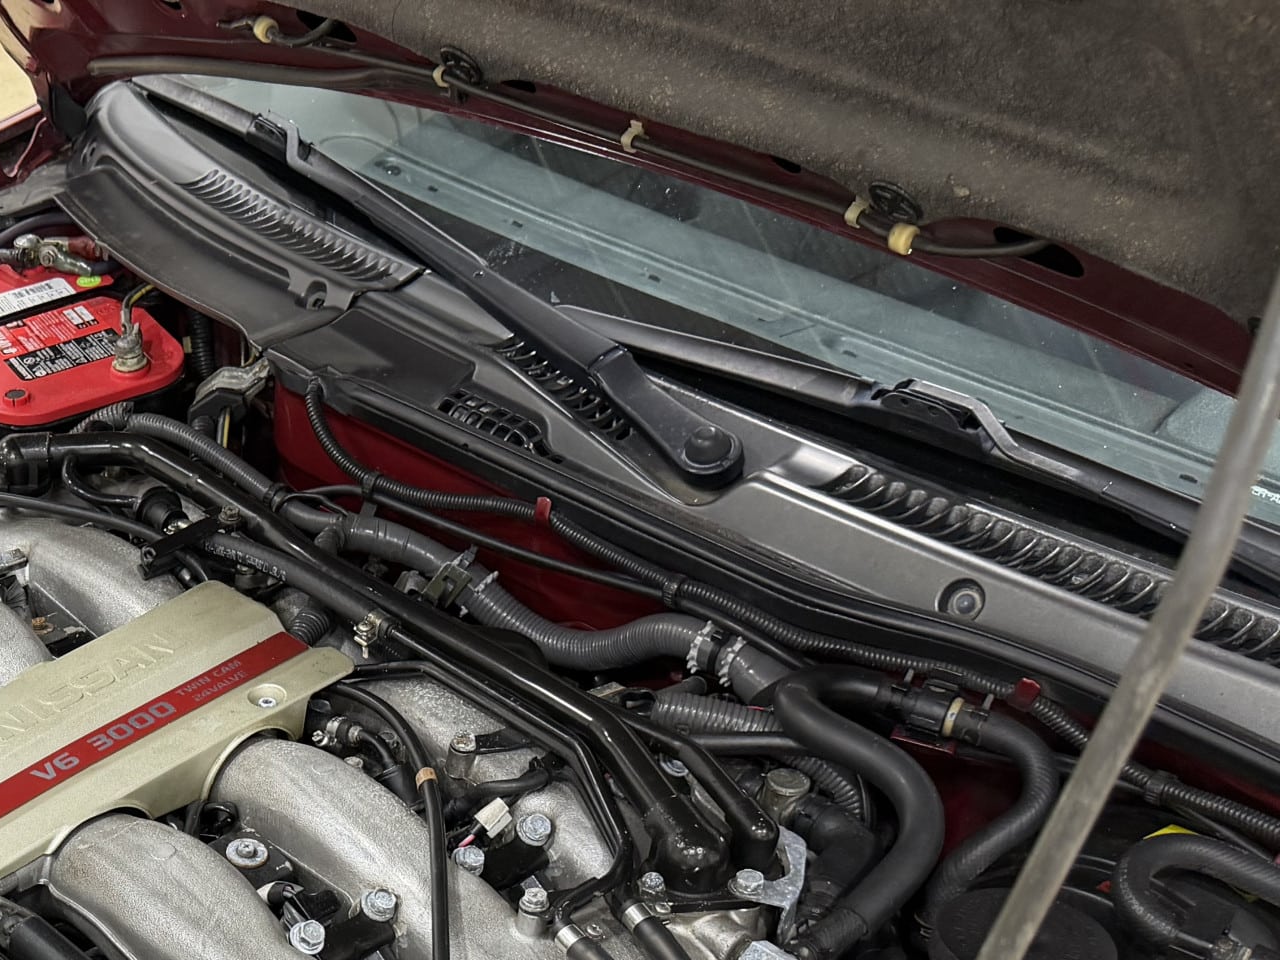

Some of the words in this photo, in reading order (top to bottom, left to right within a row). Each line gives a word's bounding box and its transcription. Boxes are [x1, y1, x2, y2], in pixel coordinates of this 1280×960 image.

[175, 675, 213, 698] TWIN
[211, 658, 243, 682] CAM
[192, 668, 250, 703] 24VALVE
[30, 751, 81, 784] V6
[86, 700, 178, 753] 3000
